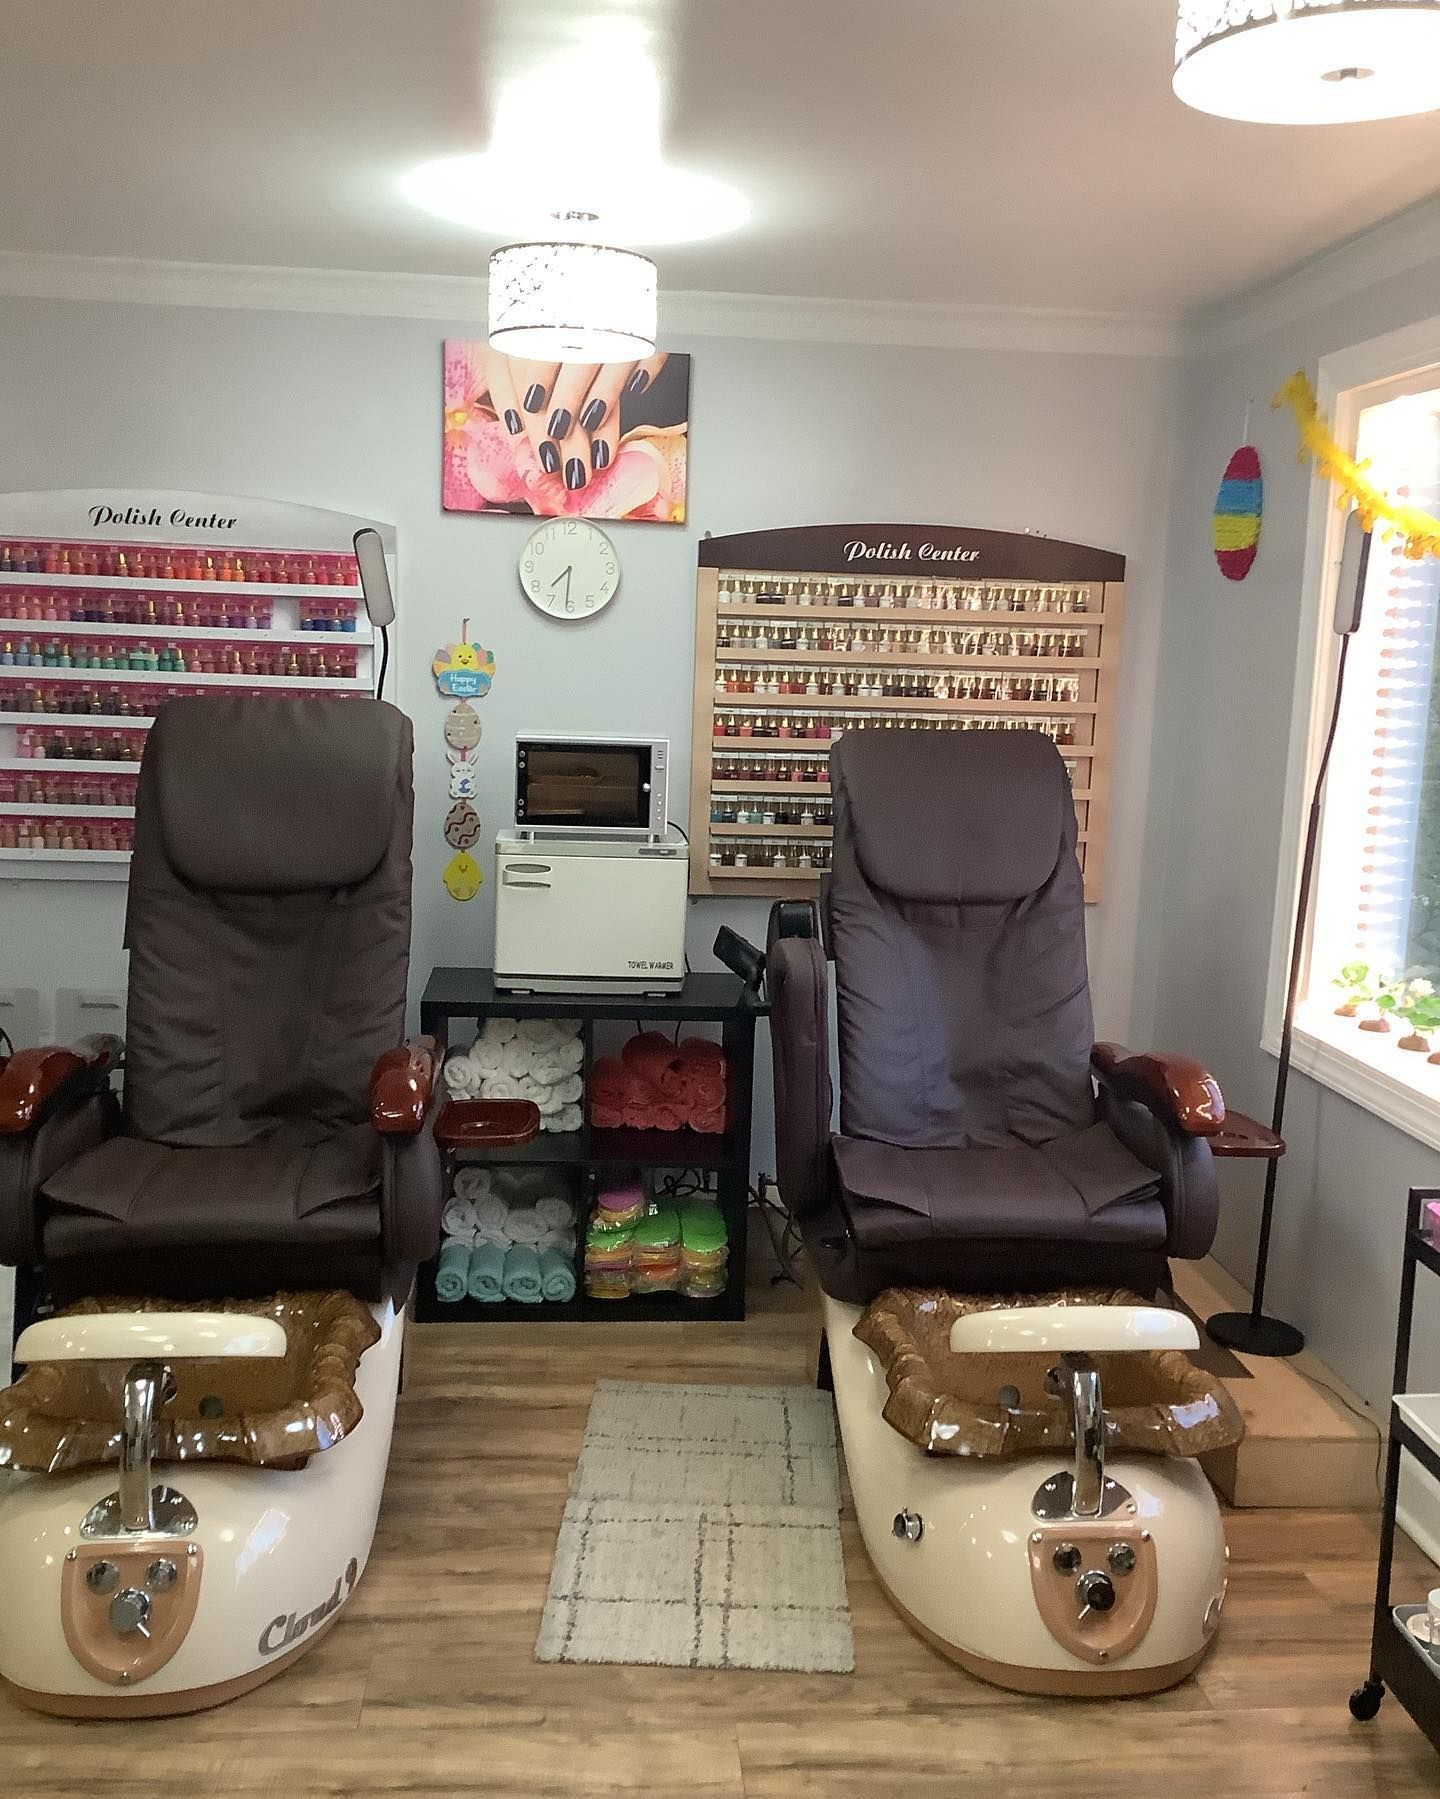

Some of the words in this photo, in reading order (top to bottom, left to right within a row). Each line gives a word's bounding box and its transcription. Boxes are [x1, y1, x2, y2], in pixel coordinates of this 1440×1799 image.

[88, 505, 162, 527] Polish
[170, 508, 238, 529] Center
[545, 527, 555, 541] 11
[562, 521, 577, 535] 12
[587, 527, 593, 541] 1
[530, 542, 545, 556] 10
[599, 541, 609, 555] 2
[843, 540, 912, 562] Polish
[918, 542, 980, 562] Center
[524, 560, 534, 573] 9
[605, 561, 615, 575] 3
[531, 580, 541, 593] 8
[599, 581, 609, 594] 4
[546, 594, 556, 608] 7
[565, 600, 575, 613] 6
[585, 594, 595, 608] 5
[450, 673, 477, 685] Happy
[627, 960, 648, 970] TOWEL
[649, 961, 674, 970] WARMER
[258, 1576, 342, 1656] Cloud
[345, 1557, 357, 1595] 9
